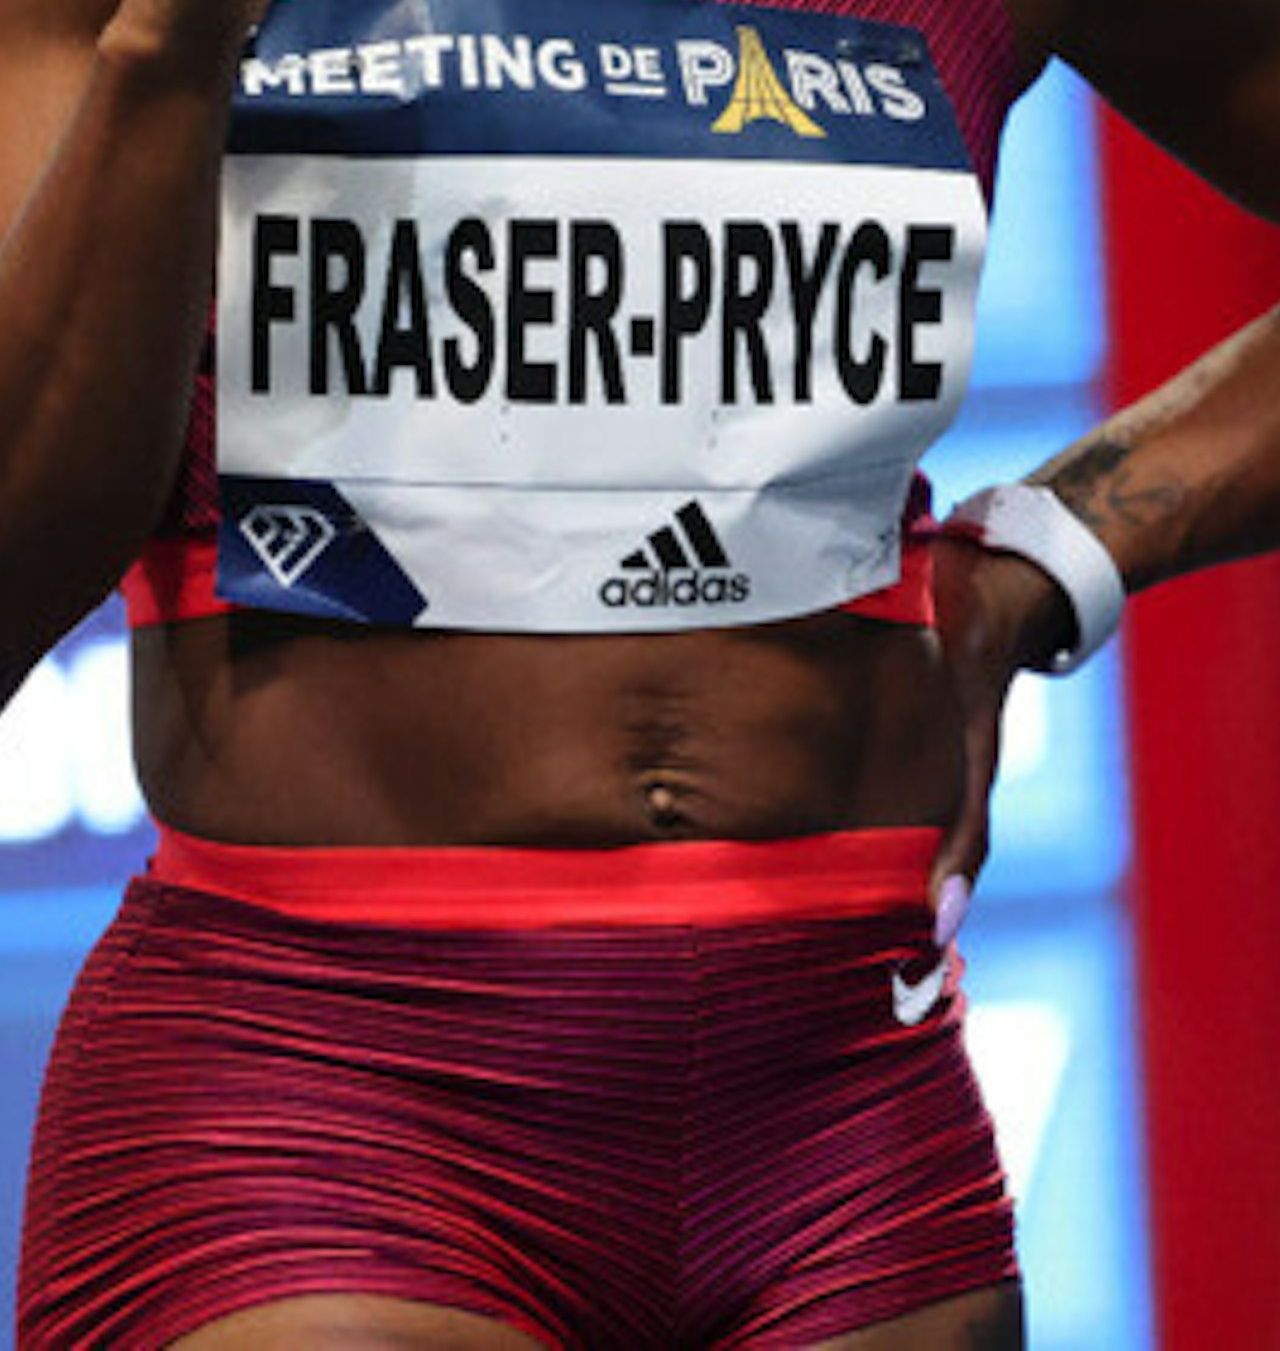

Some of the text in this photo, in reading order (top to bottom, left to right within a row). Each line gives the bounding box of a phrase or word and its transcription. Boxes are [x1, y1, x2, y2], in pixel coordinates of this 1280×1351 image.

[240, 25, 926, 137] MEETING DE PARIS
[250, 213, 954, 406] FRASER-PRYCE
[599, 567, 754, 609] adidas
